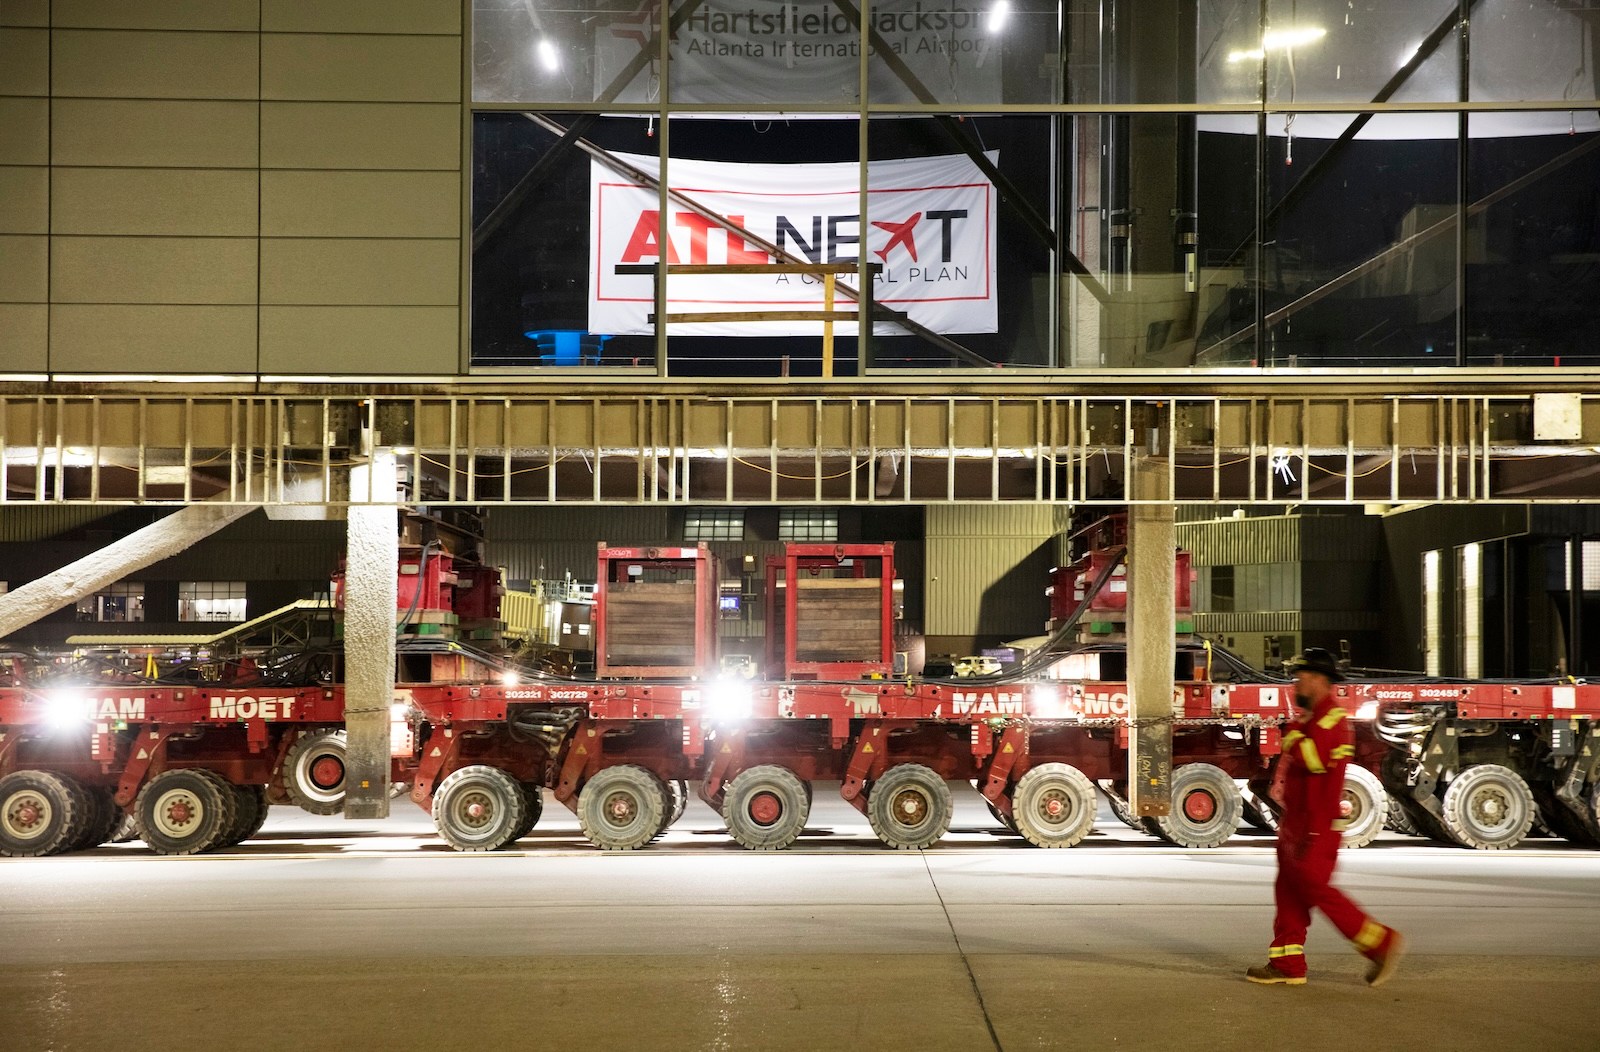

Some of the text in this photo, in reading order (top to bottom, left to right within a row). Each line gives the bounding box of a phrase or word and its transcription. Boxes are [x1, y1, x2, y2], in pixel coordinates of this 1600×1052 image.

[686, 37, 990, 58] Atlanta Internatial Airpor
[775, 266, 968, 285] A CPIAL PLAN
[505, 690, 588, 699] 302321 302729
[953, 692, 1130, 714] MAM MO
[210, 696, 295, 719] MOET
